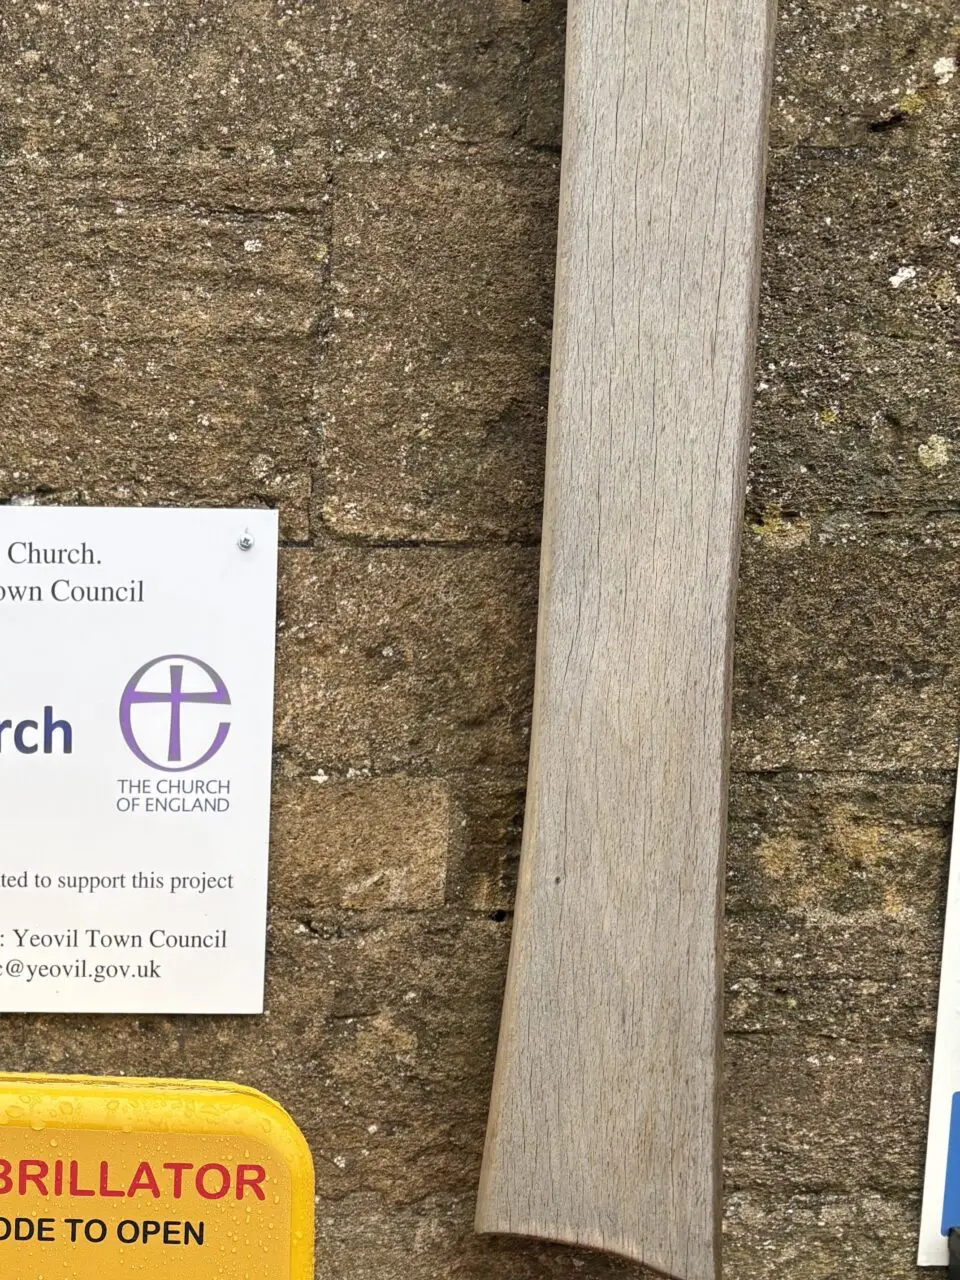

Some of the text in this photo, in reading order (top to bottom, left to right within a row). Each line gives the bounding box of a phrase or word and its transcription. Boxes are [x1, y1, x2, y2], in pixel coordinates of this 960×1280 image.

[7, 542, 102, 567] Church.
[50, 581, 144, 604] Council
[117, 780, 231, 795] THE CHURCH
[116, 798, 230, 812] OF ENGLAND
[34, 874, 52, 890] to
[58, 871, 125, 895] support
[131, 871, 165, 891] this
[171, 871, 234, 896] project
[13, 928, 80, 949] Yeovil
[85, 930, 144, 949] Town
[149, 929, 228, 949] Council
[63, 1217, 108, 1244] TO
[116, 1218, 205, 1246] OPEN
